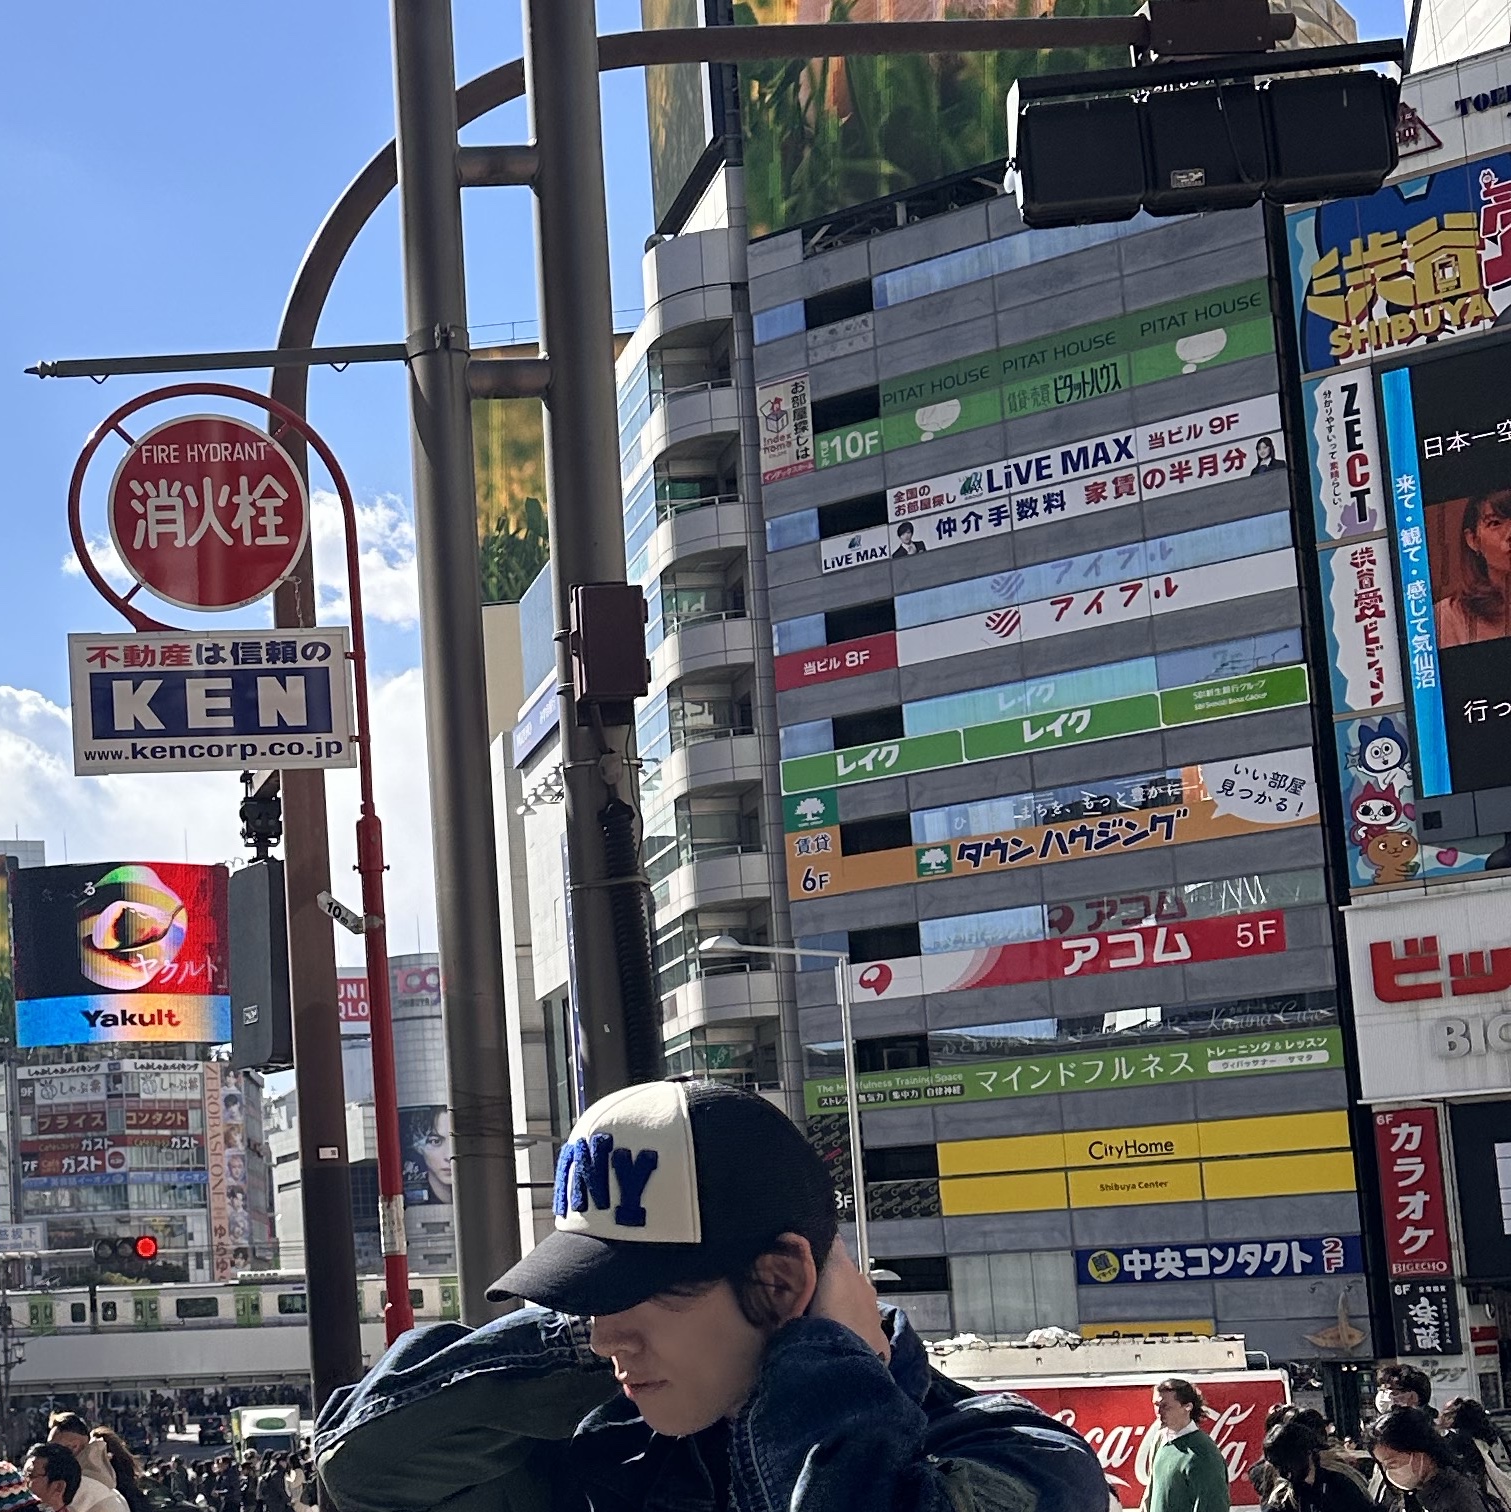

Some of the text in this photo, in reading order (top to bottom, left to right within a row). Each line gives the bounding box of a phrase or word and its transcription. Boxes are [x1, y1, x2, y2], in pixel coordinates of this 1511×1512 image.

[1140, 293, 1263, 336] PITAT HOUSE
[1329, 294, 1497, 356] SHIBUYA
[1002, 330, 1117, 374] PITAT HOUSE
[882, 365, 991, 407] PITAT HOUSE
[830, 431, 878, 462] 10F
[1148, 413, 1240, 450] 当ビル 9F
[141, 441, 268, 465] FIRE HYDRANT
[1061, 435, 1135, 476] MAX
[1340, 383, 1371, 522] ZECT
[128, 473, 290, 550] 消火栓
[935, 490, 1066, 540] 仲介手数料
[856, 545, 888, 563] MAX
[1050, 577, 1178, 622] アイフル
[86, 641, 332, 669] 不動産は信頼の
[845, 650, 870, 667] 8F
[112, 676, 308, 731] KEN
[1022, 709, 1091, 743] レイク
[84, 737, 343, 762] www.kencorp.co.jp
[836, 744, 900, 776] レイク
[1233, 763, 1306, 796] いい部屋
[957, 808, 1189, 869] タウンハウジング
[801, 867, 830, 893] 6F
[1236, 919, 1277, 948] 5F
[1061, 927, 1192, 976] アコム
[80, 1009, 181, 1028] Yakult
[817, 1085, 834, 1094] The
[935, 1073, 963, 1084] Space
[975, 1051, 1194, 1093] マインドフルネス
[126, 1111, 187, 1125] コンタクト
[81, 1138, 114, 1151] ガスト
[171, 1136, 199, 1149] ガスト
[1088, 1139, 1174, 1160] CityHome
[22, 1161, 38, 1172] 7F
[62, 1156, 103, 1173] ガスト
[552, 1131, 658, 1227] NY
[1099, 1180, 1168, 1192] Shibuya Center
[1390, 1122, 1434, 1255] カラオケ
[1123, 1241, 1313, 1280] 中央コンタクト
[1322, 1238, 1344, 1273] 2F
